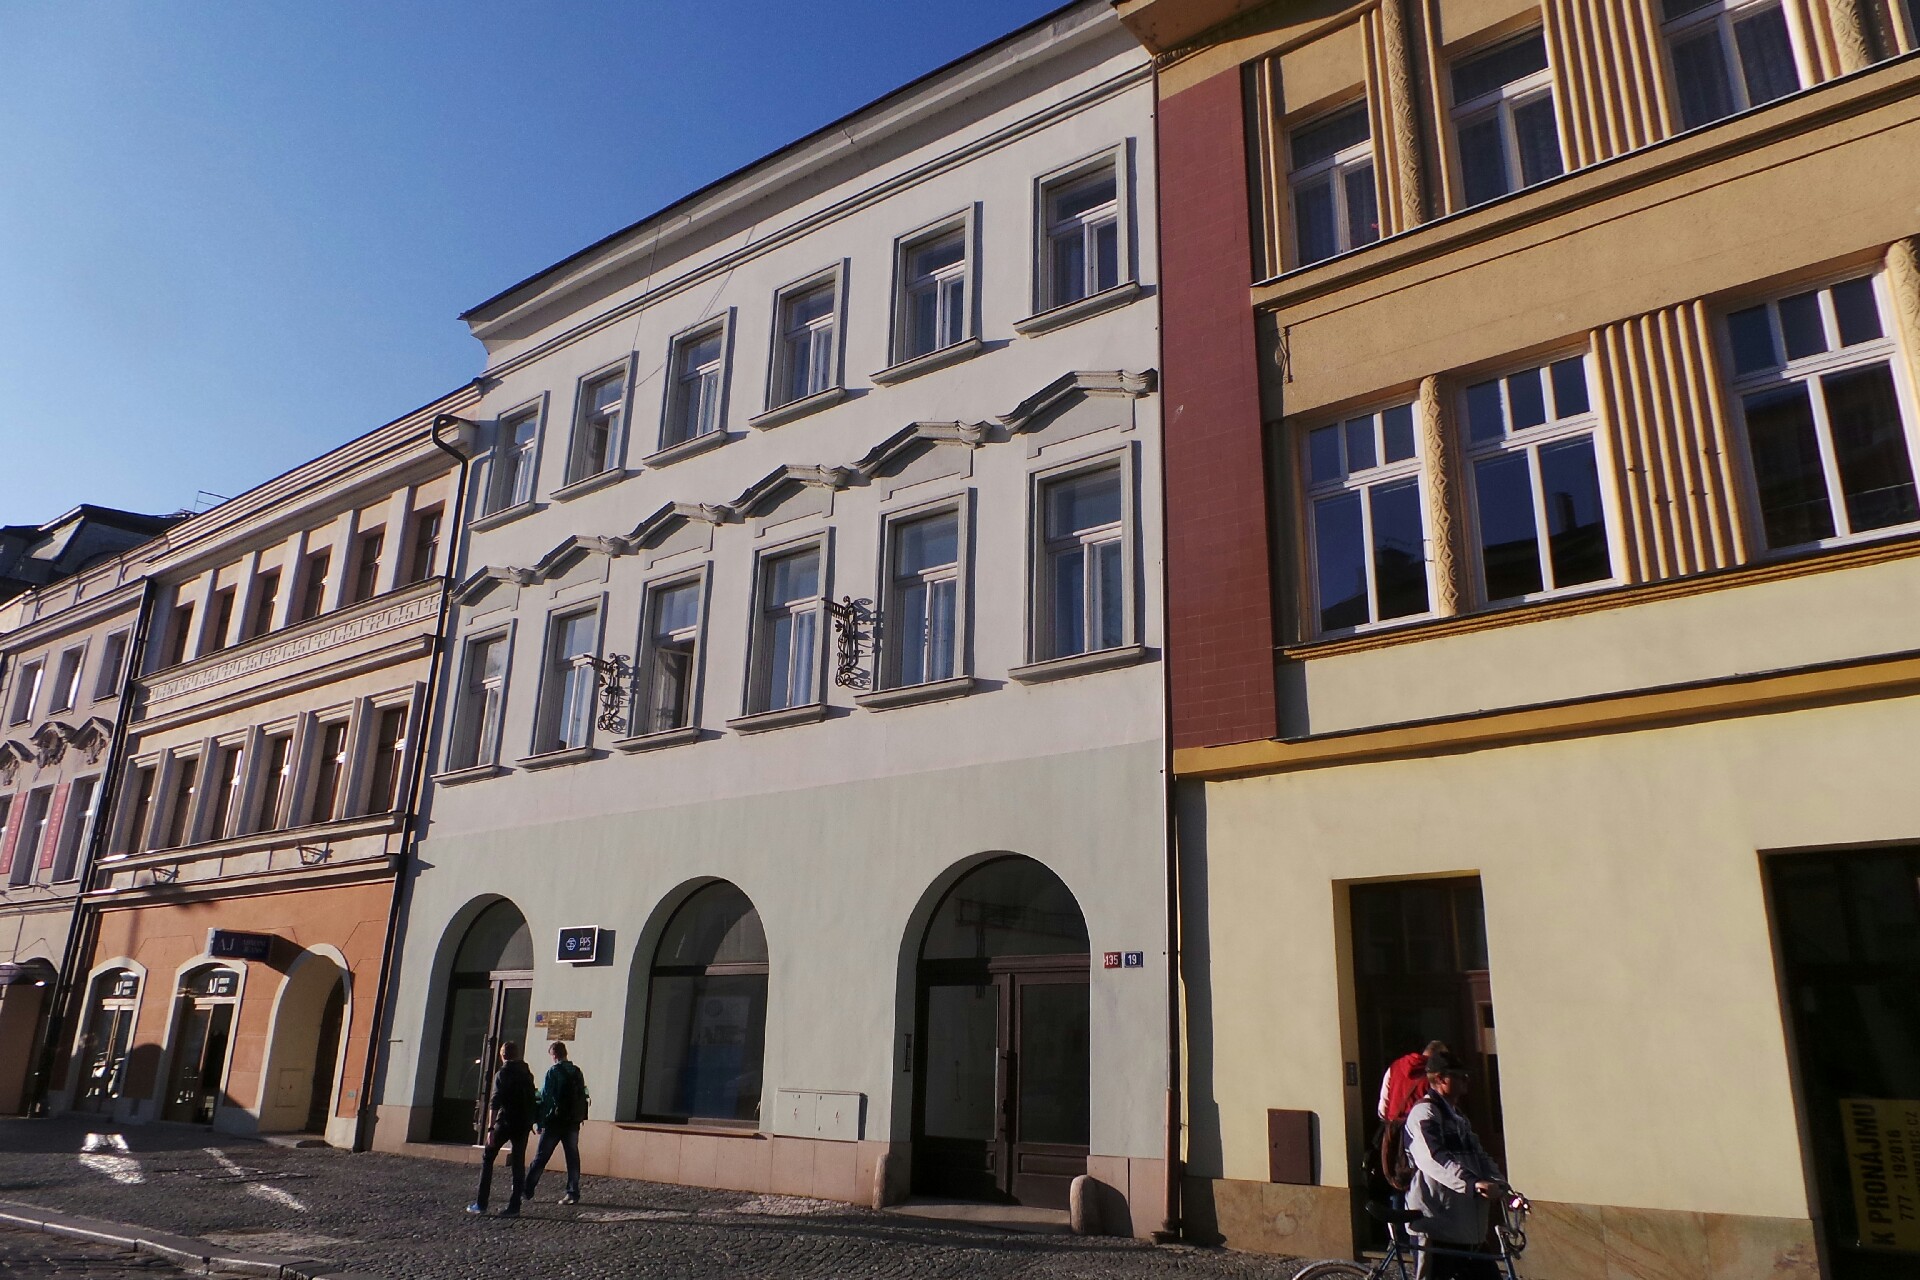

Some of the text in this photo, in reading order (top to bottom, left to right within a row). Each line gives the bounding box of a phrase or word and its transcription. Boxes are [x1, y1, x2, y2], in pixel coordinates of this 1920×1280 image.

[579, 937, 592, 947] PPS
[1105, 954, 1119, 966] 135
[1127, 954, 1137, 965] 19
[1852, 1104, 1896, 1245] K PRONÁJMU
[1897, 1195, 1915, 1220] 777
